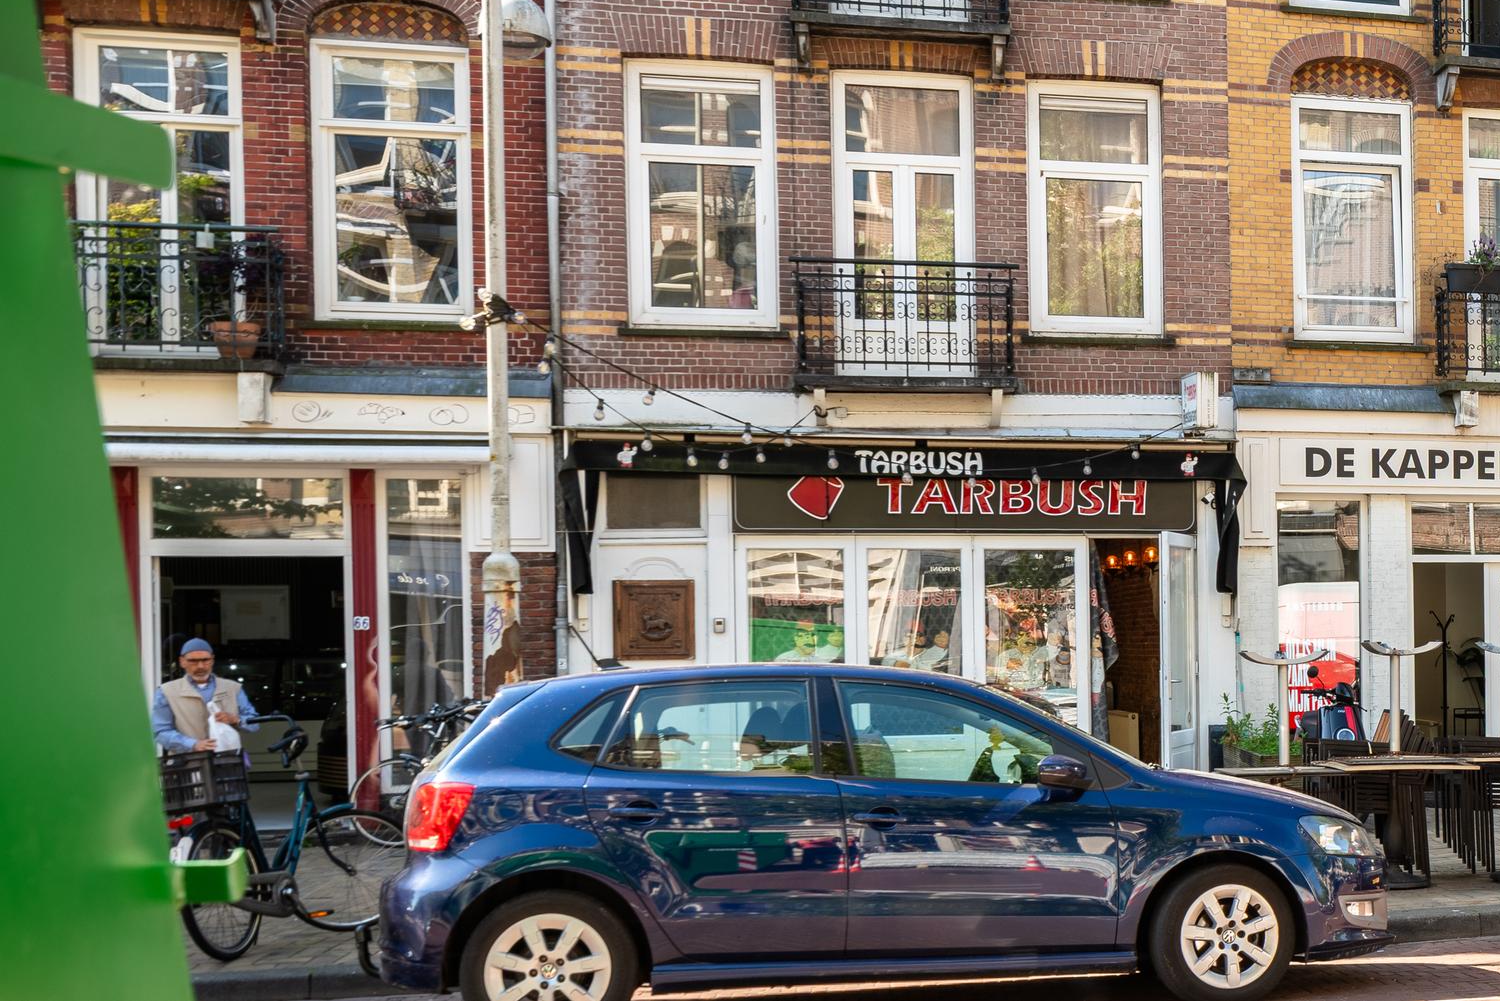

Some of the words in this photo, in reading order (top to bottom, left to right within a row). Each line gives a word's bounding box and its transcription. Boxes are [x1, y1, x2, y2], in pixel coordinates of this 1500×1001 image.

[855, 450, 983, 476] TARBUSH
[1305, 447, 1355, 478] DE
[877, 478, 1148, 516] TARBUSH
[353, 616, 371, 630] 66
